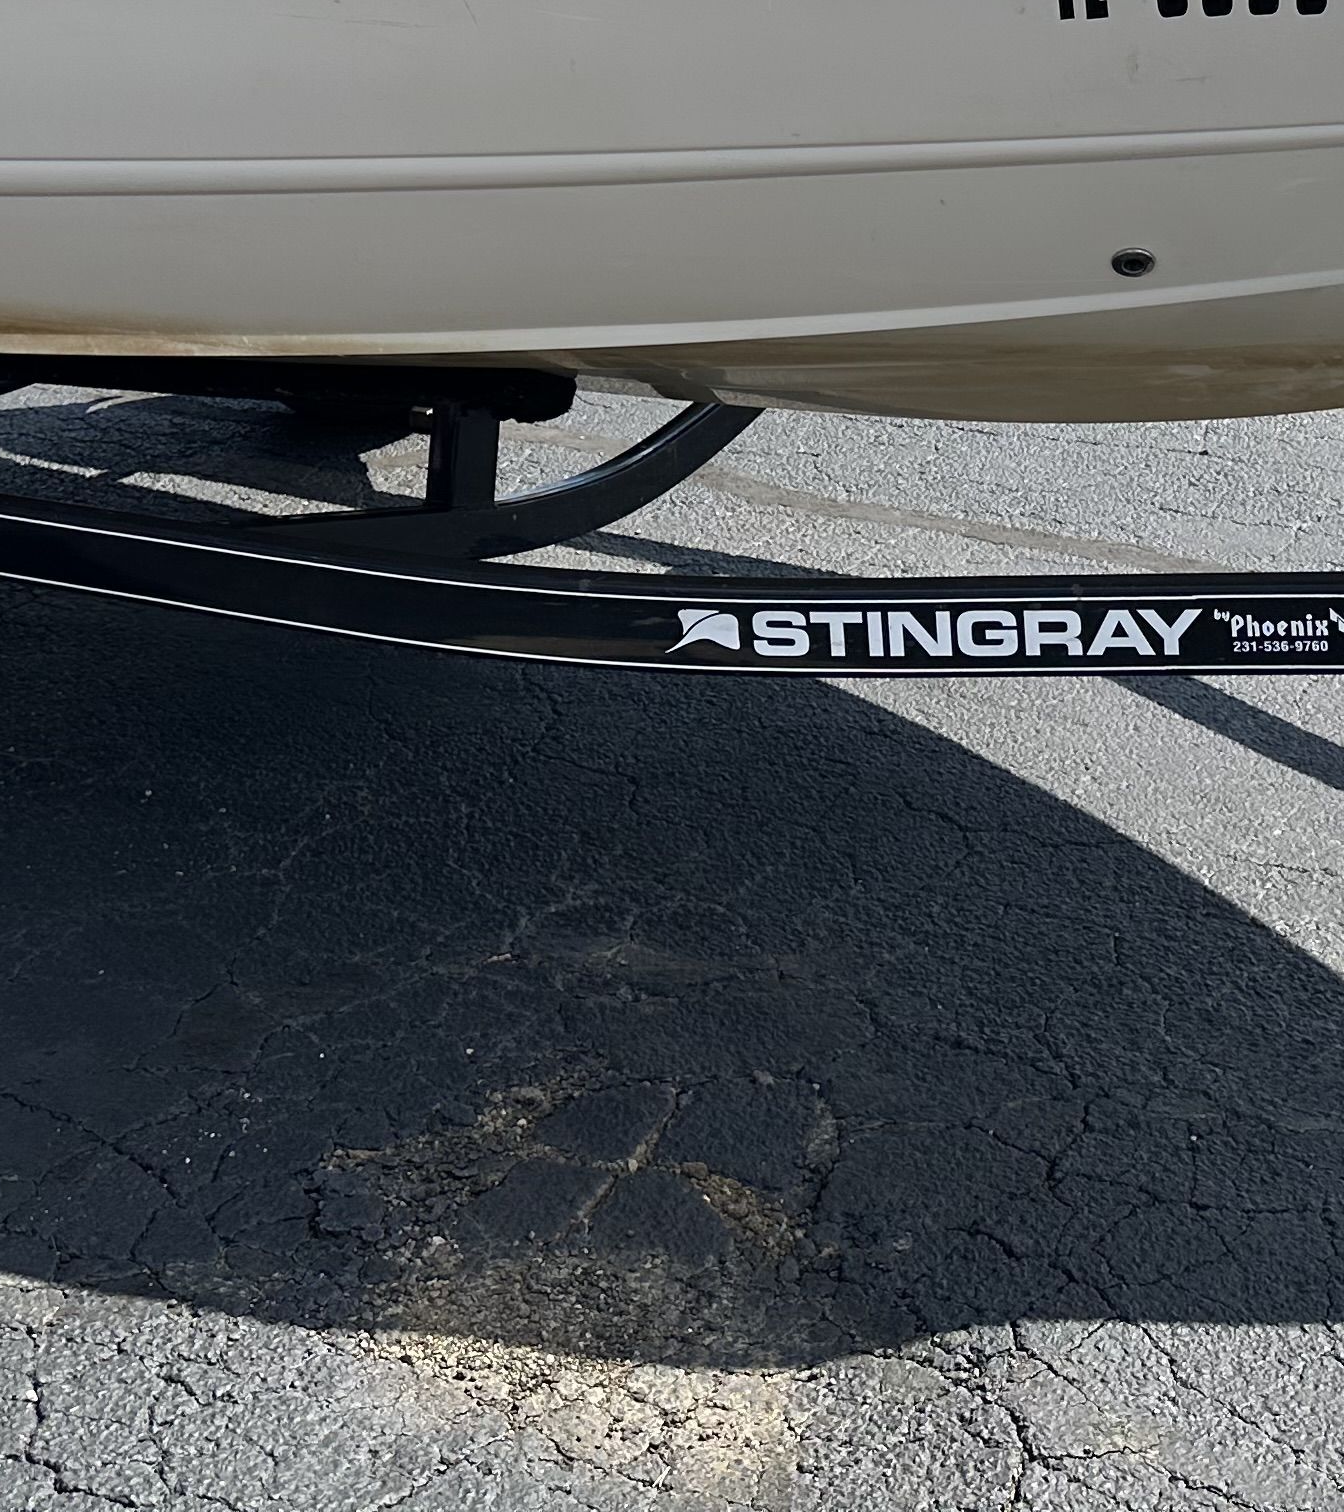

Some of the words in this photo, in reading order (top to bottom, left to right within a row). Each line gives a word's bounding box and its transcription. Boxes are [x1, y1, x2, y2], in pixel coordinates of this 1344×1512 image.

[753, 608, 1203, 658] STINGRAY
[1213, 609, 1230, 622] by
[1231, 613, 1329, 637] Phoenix
[1233, 640, 1329, 652] 231-536-9760
